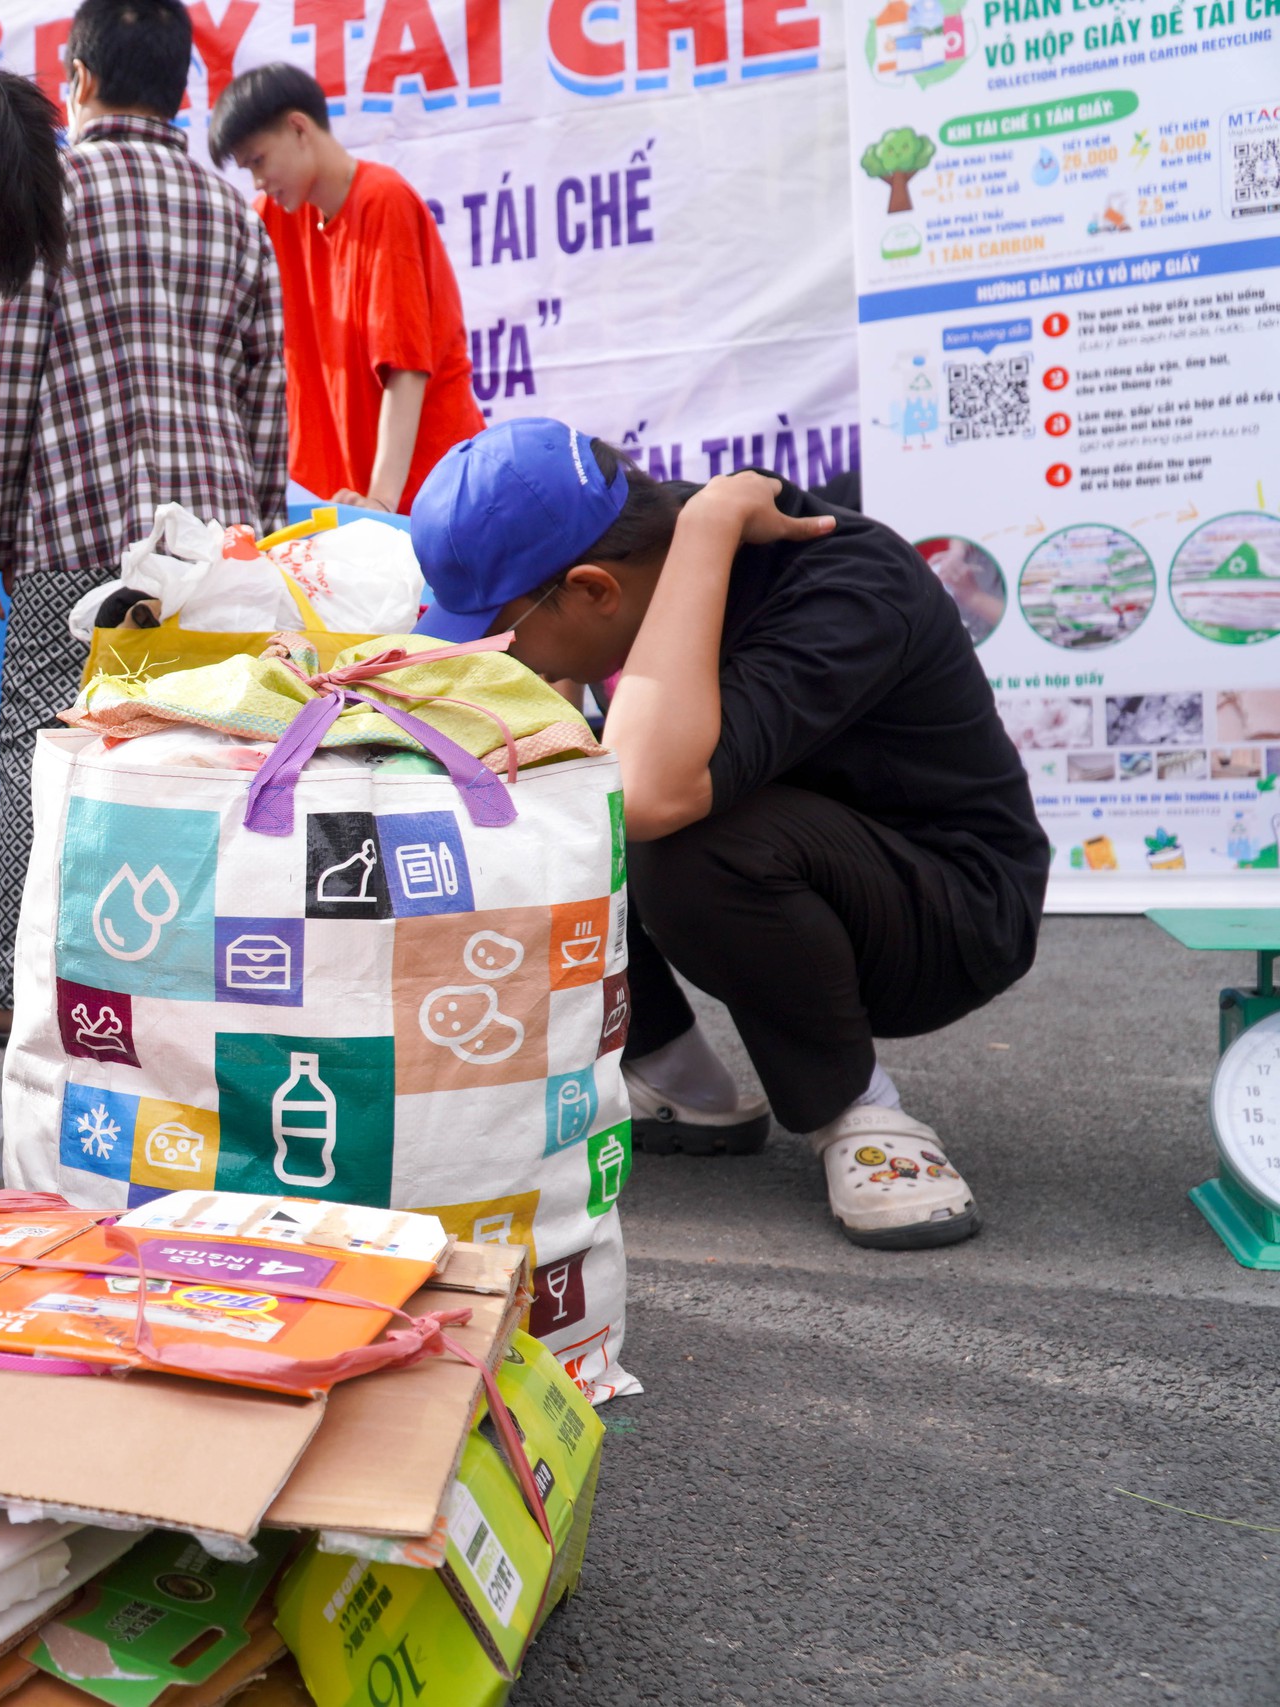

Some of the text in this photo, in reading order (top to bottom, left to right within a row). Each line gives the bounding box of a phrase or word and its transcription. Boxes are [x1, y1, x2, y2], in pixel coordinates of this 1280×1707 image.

[985, 33, 1016, 68] VỎ
[1024, 29, 1075, 65] HỘP
[987, 28, 1272, 91] COLLECTION PROGRAM FOR CARTON RECYCLING
[947, 125, 971, 142] KHI
[975, 117, 998, 138] TÁI
[463, 171, 537, 267] TÁI
[556, 138, 654, 255] CHẾ
[978, 236, 1045, 259] CARBON
[1257, 1064, 1272, 1077] 17
[1246, 1085, 1261, 1097] 16
[1242, 1107, 1264, 1123] 15
[1249, 1135, 1264, 1147] 14
[159, 1247, 256, 1266] INSIDE
[167, 1254, 305, 1276] 4 BAGS
[181, 1289, 271, 1312] Tide
